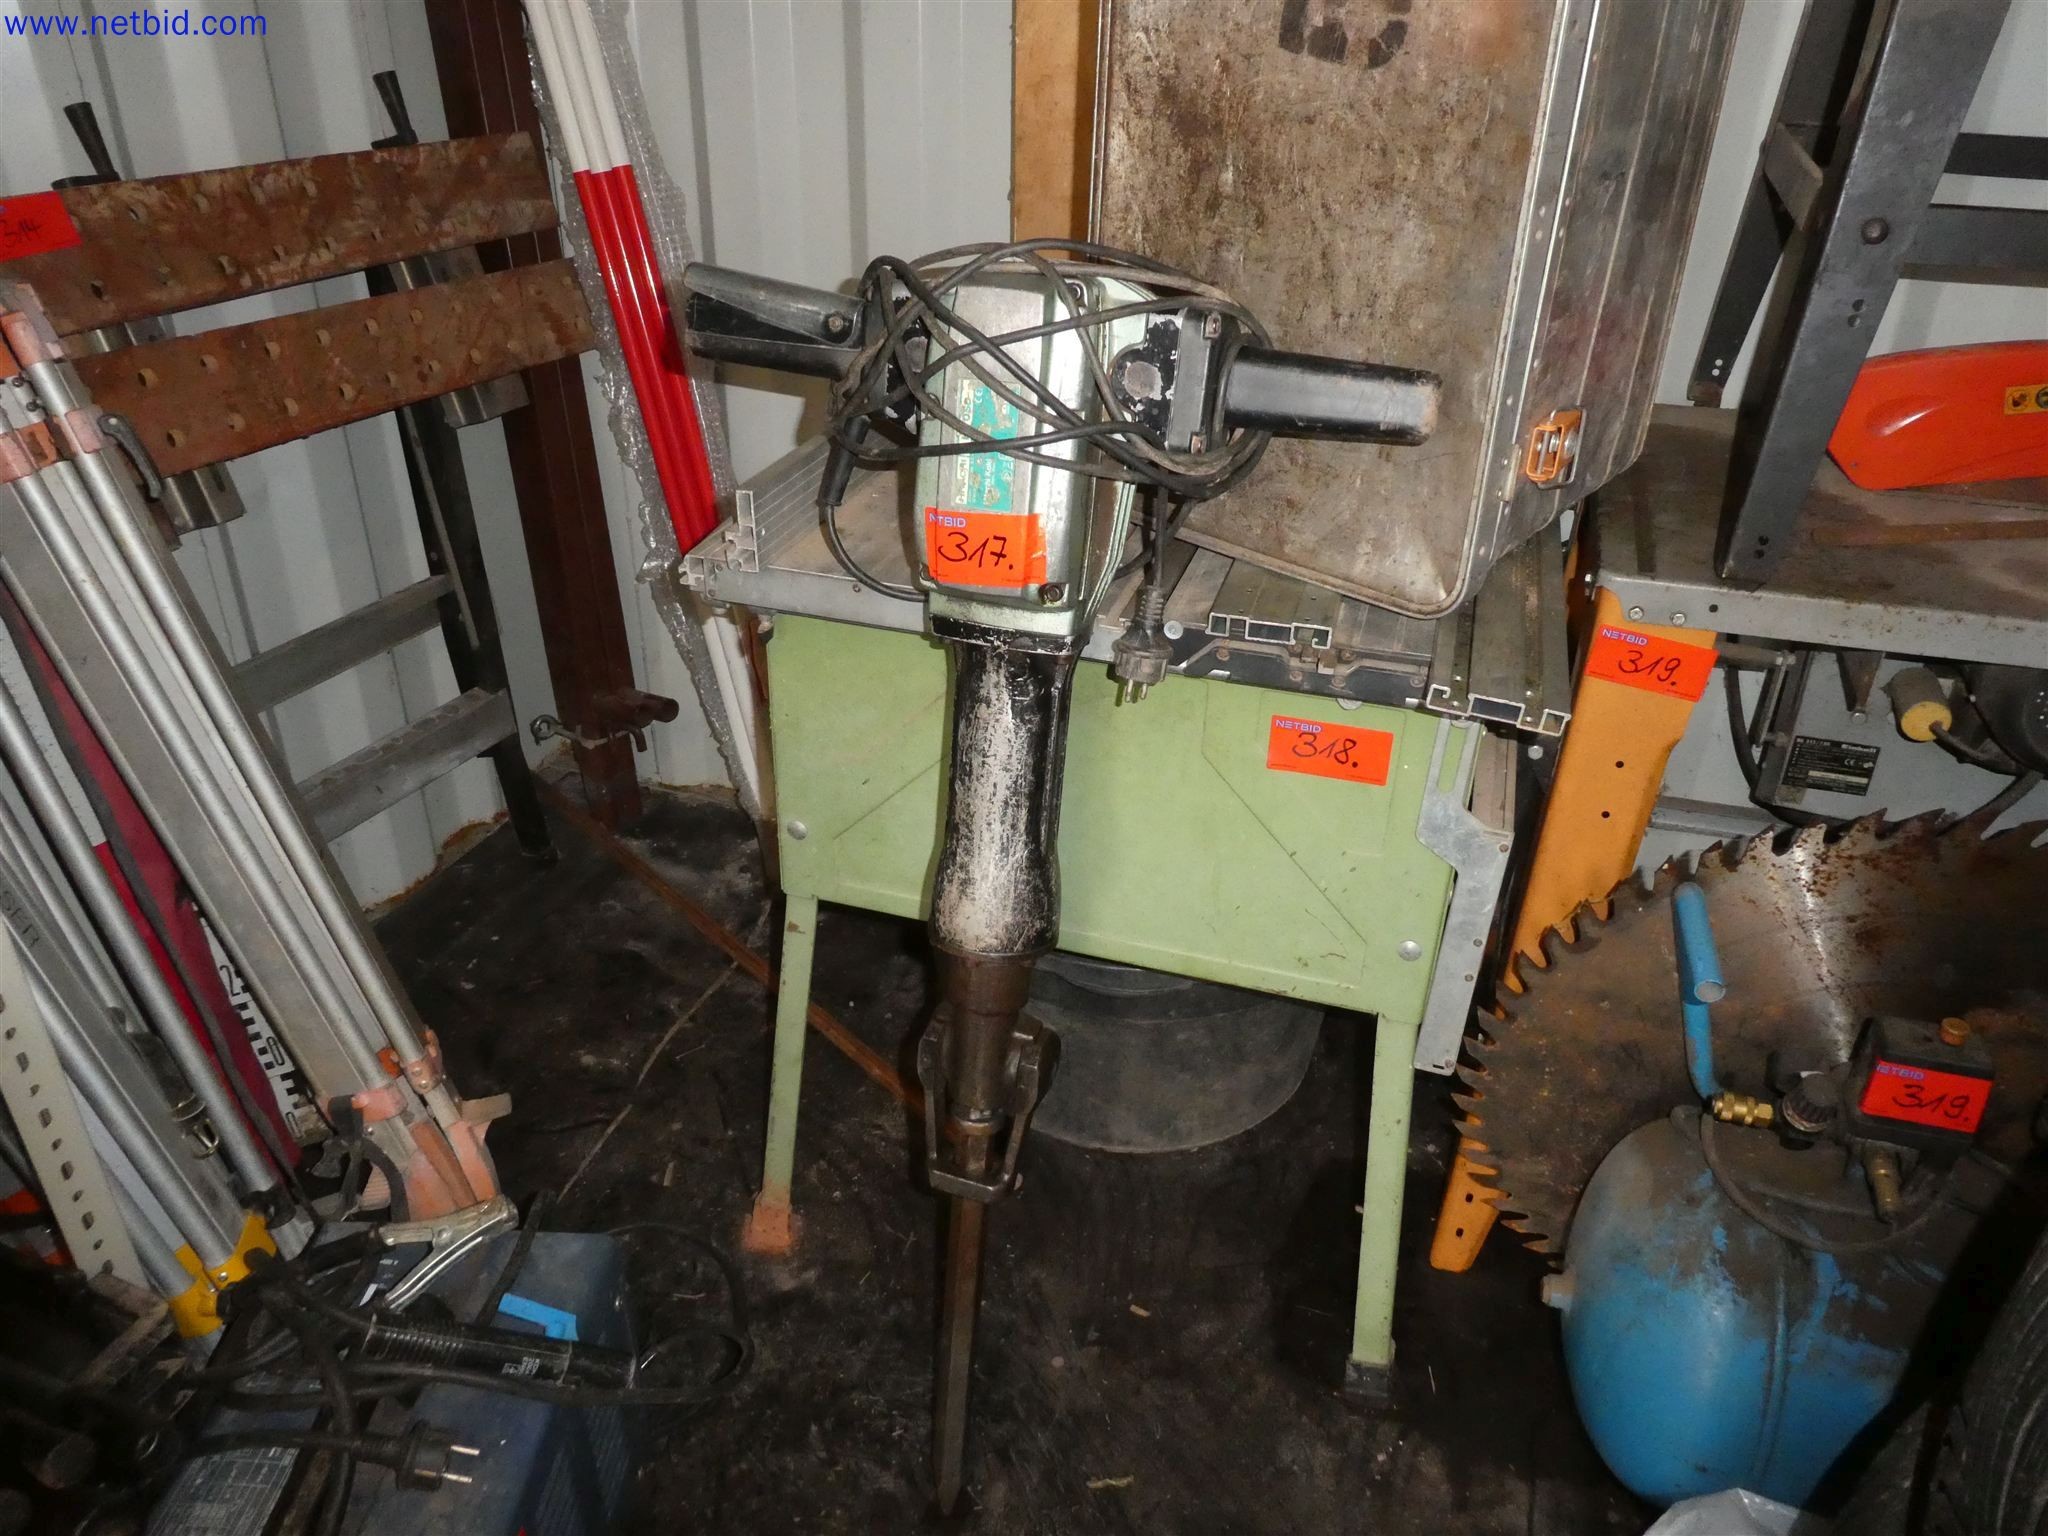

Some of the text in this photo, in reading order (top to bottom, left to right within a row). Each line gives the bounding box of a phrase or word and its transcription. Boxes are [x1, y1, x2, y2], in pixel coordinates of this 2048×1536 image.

[1602, 628, 1648, 646] NETBID
[1618, 650, 1681, 686] 319.
[1275, 719, 1322, 733] NETBID
[1292, 732, 1359, 768] 318.
